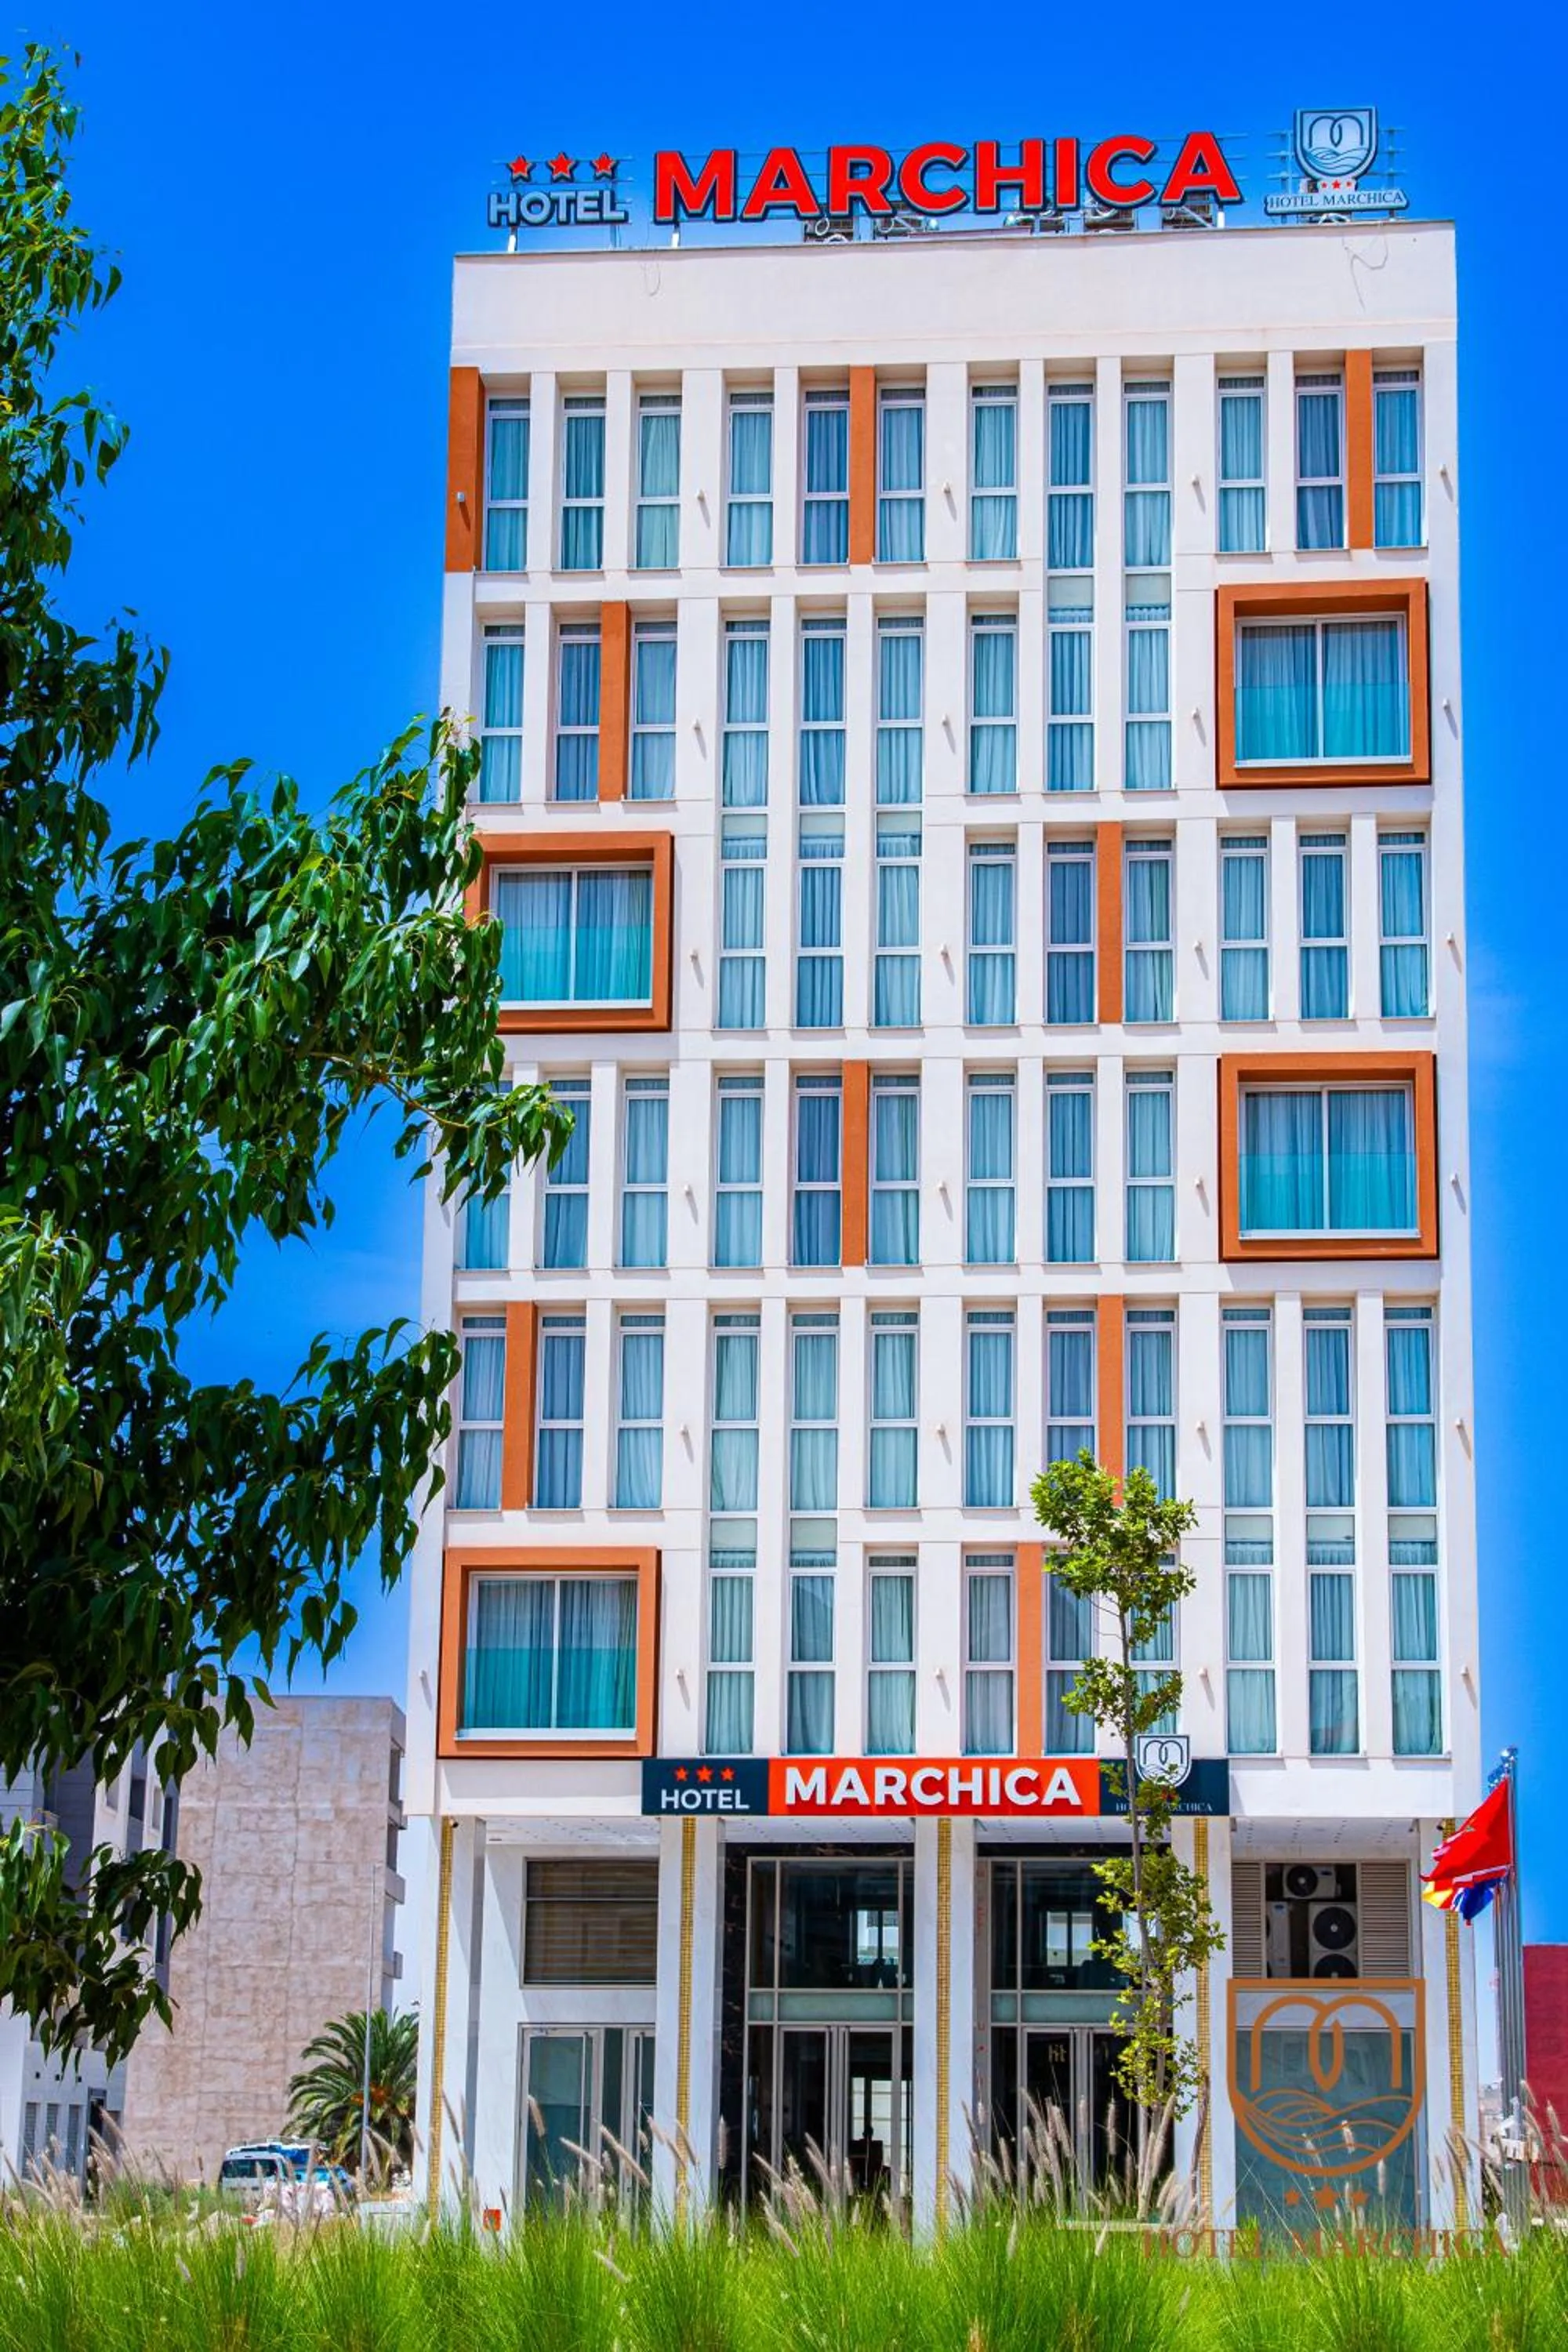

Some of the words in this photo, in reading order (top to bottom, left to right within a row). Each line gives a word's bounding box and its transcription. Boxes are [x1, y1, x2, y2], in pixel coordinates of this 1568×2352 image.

[488, 190, 628, 227] HOTEL
[653, 131, 1244, 223] MARCHICA
[1269, 195, 1319, 208] HOTEL
[1323, 191, 1403, 206] MARCHICA
[660, 1788, 750, 1809] HOTEL
[785, 1766, 1083, 1806] MARCHICA
